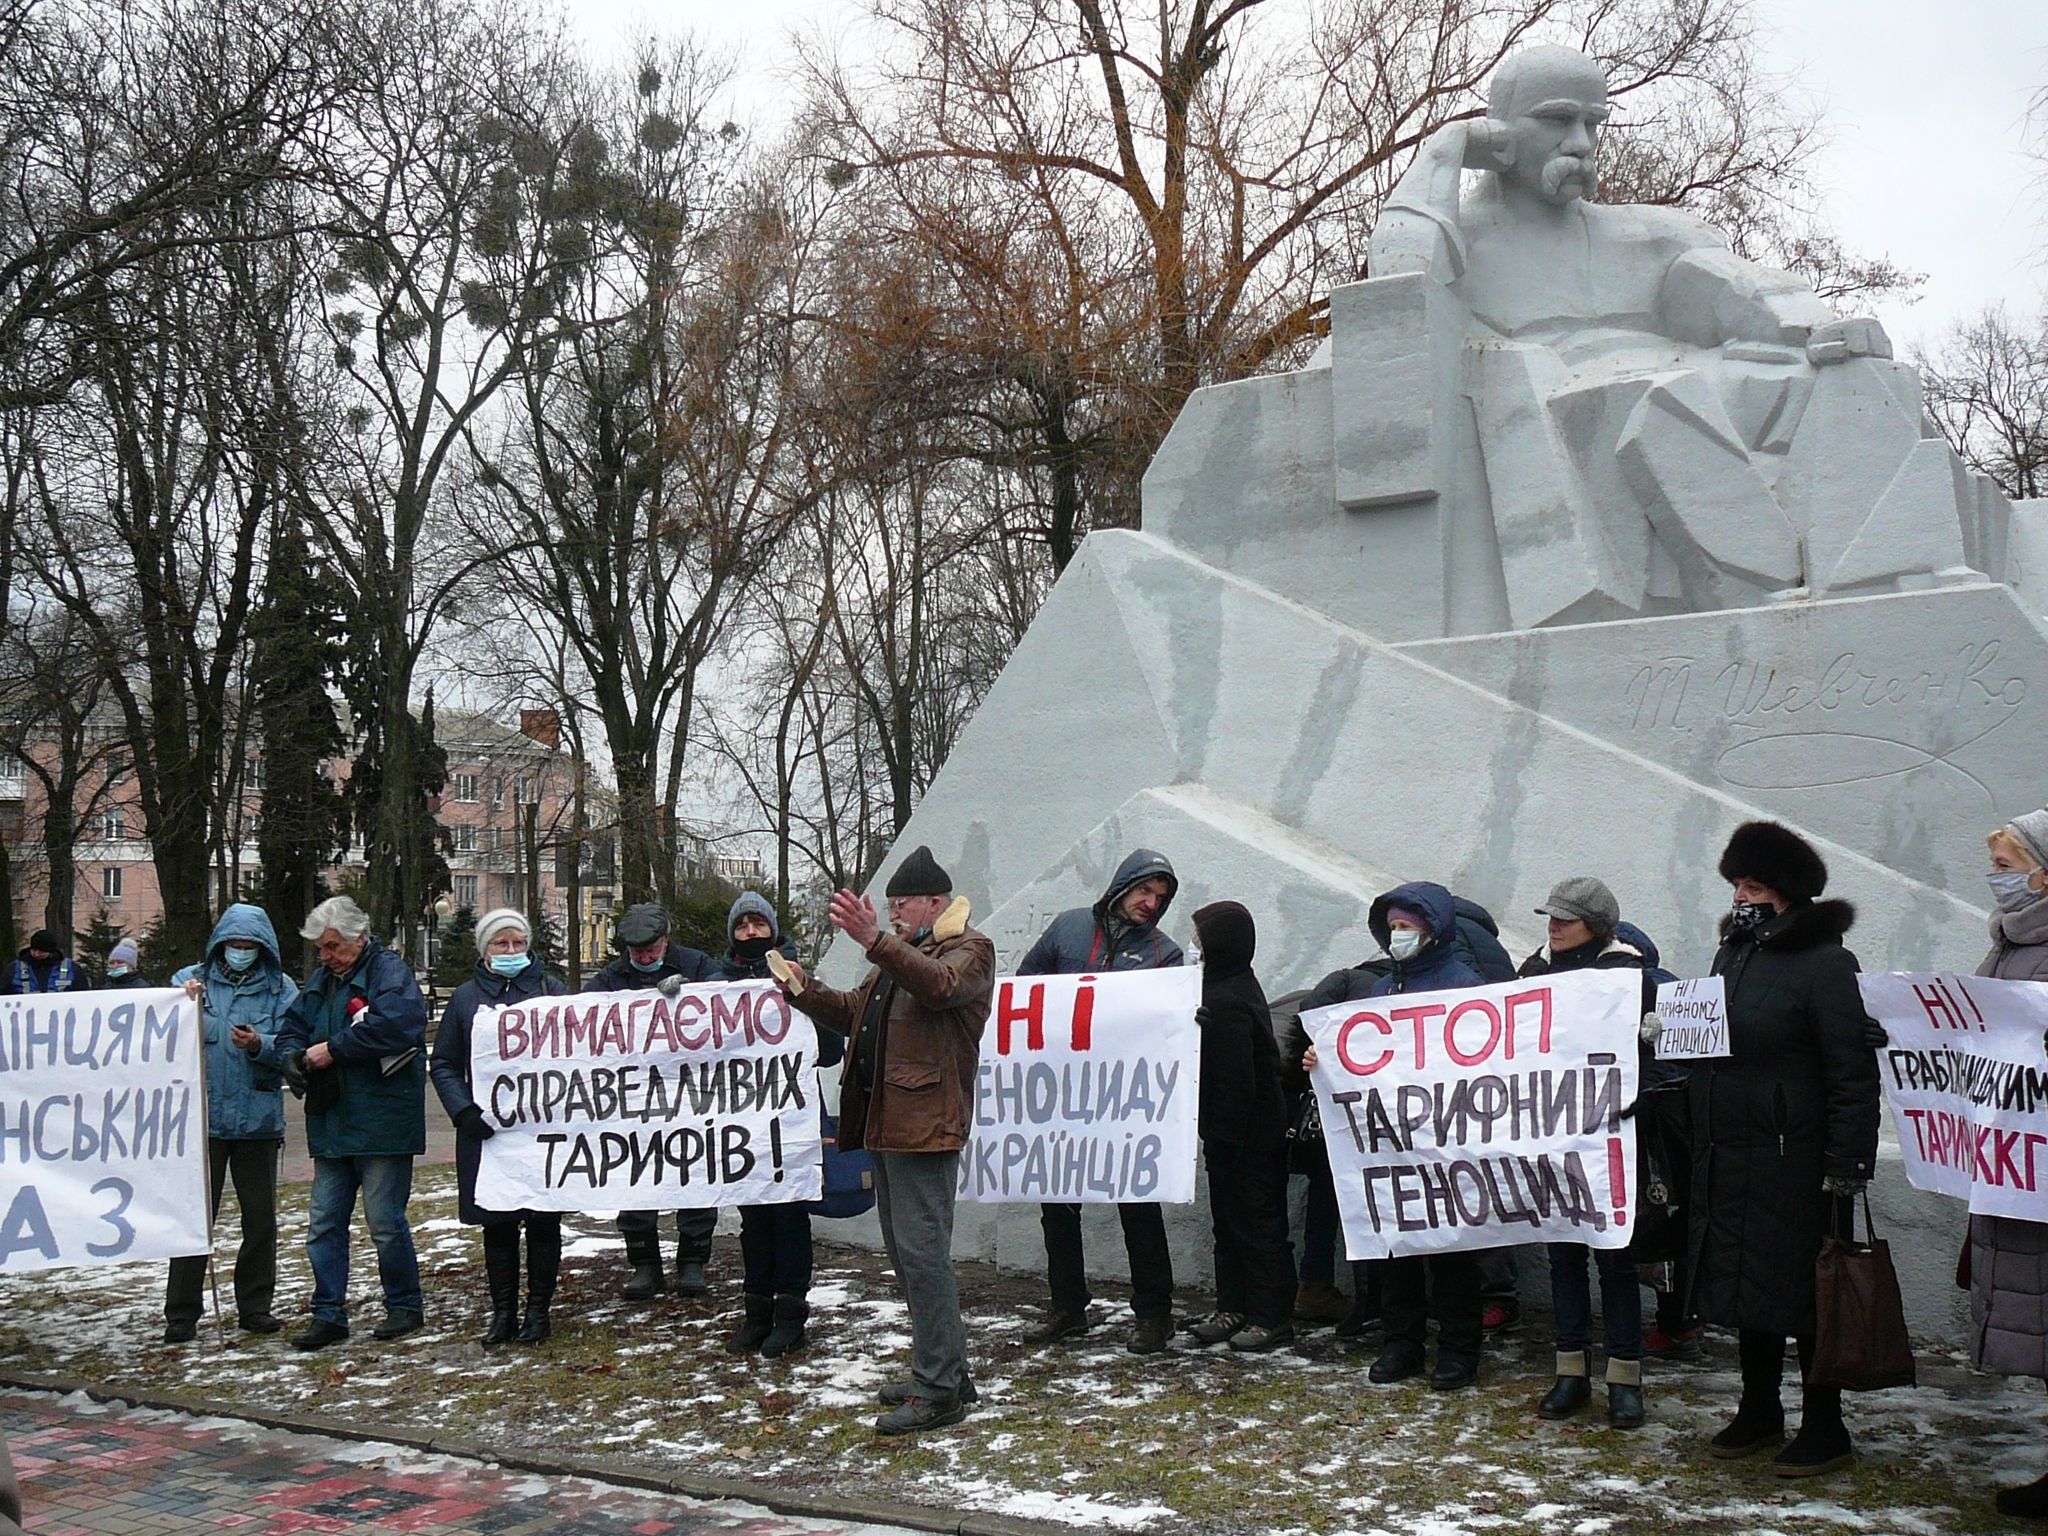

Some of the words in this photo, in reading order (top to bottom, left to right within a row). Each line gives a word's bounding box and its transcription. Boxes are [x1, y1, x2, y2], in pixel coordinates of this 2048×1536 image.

[498, 989, 792, 1062] ВИМАГАЄМО
[996, 975, 1098, 1057] НІ
[1336, 987, 1552, 1077] СТОП
[491, 1050, 806, 1128] СПРАВЕДЛИВИХ
[974, 1056, 1180, 1126] ЕНОЦИДУ
[1332, 1052, 1622, 1154] ТАРИФНИЙ
[958, 1130, 1162, 1199] УКРАЇНЦІВ
